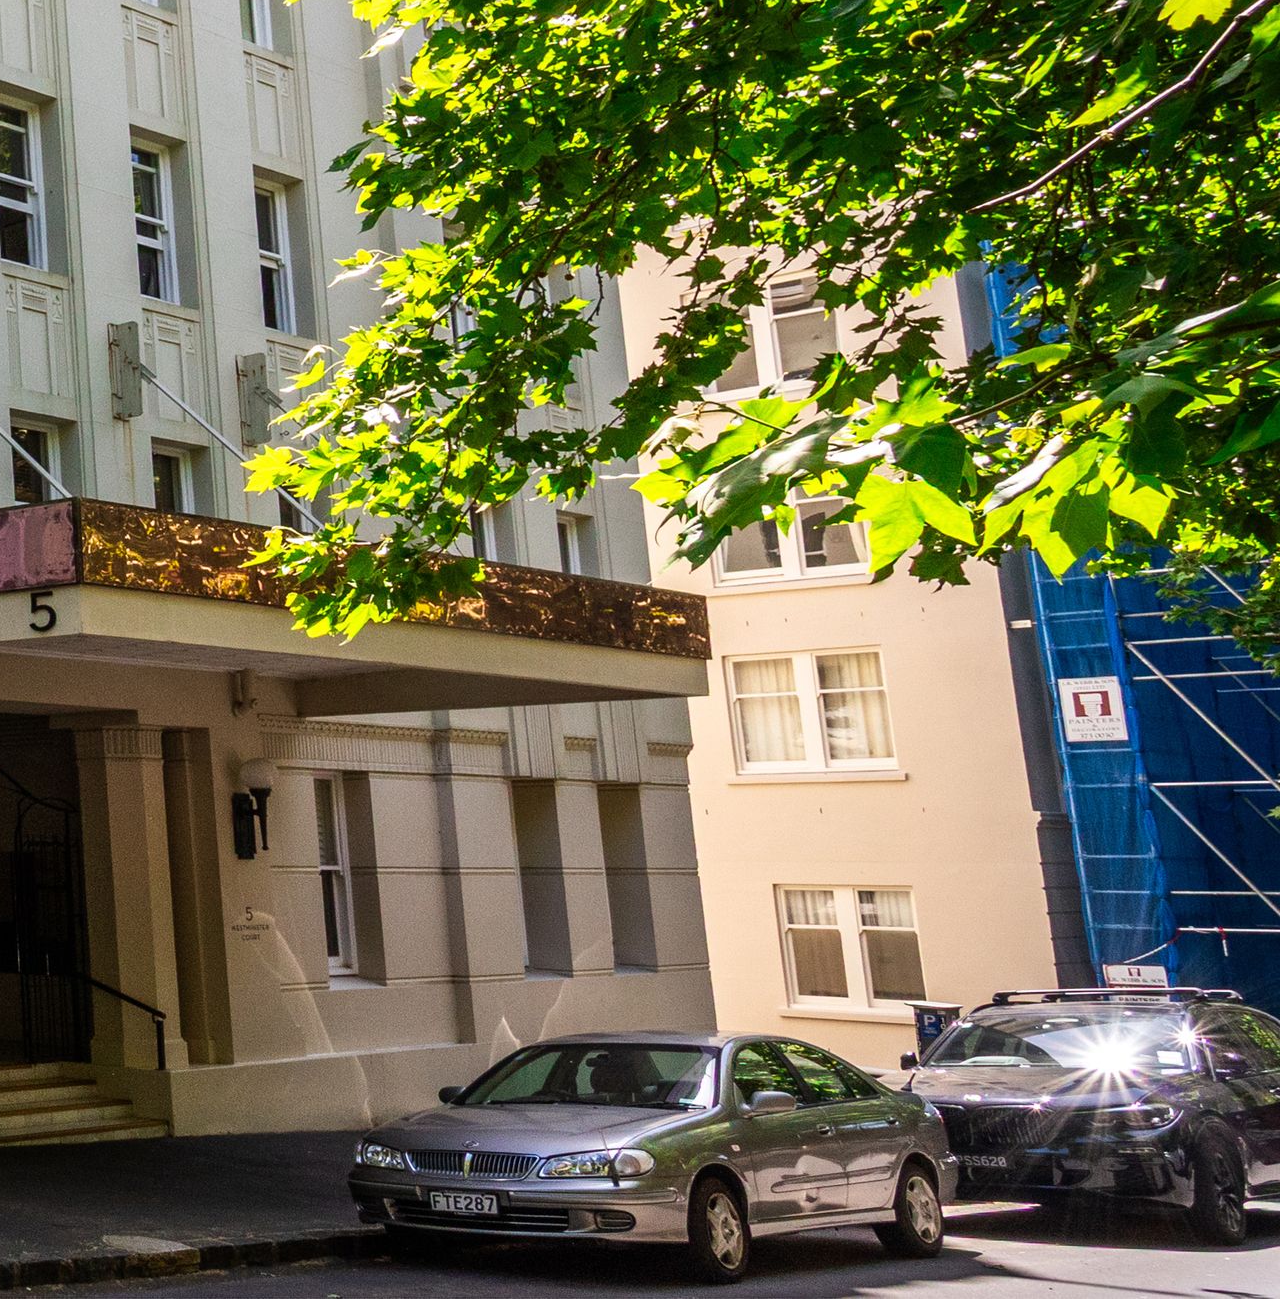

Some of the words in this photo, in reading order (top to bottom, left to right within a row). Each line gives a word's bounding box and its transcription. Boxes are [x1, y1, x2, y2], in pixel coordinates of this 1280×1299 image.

[29, 590, 57, 633] 5
[1069, 717, 1121, 725] PAINTERS
[245, 906, 254, 922] 5
[923, 1014, 936, 1026] P
[432, 1194, 495, 1212] FTE287
